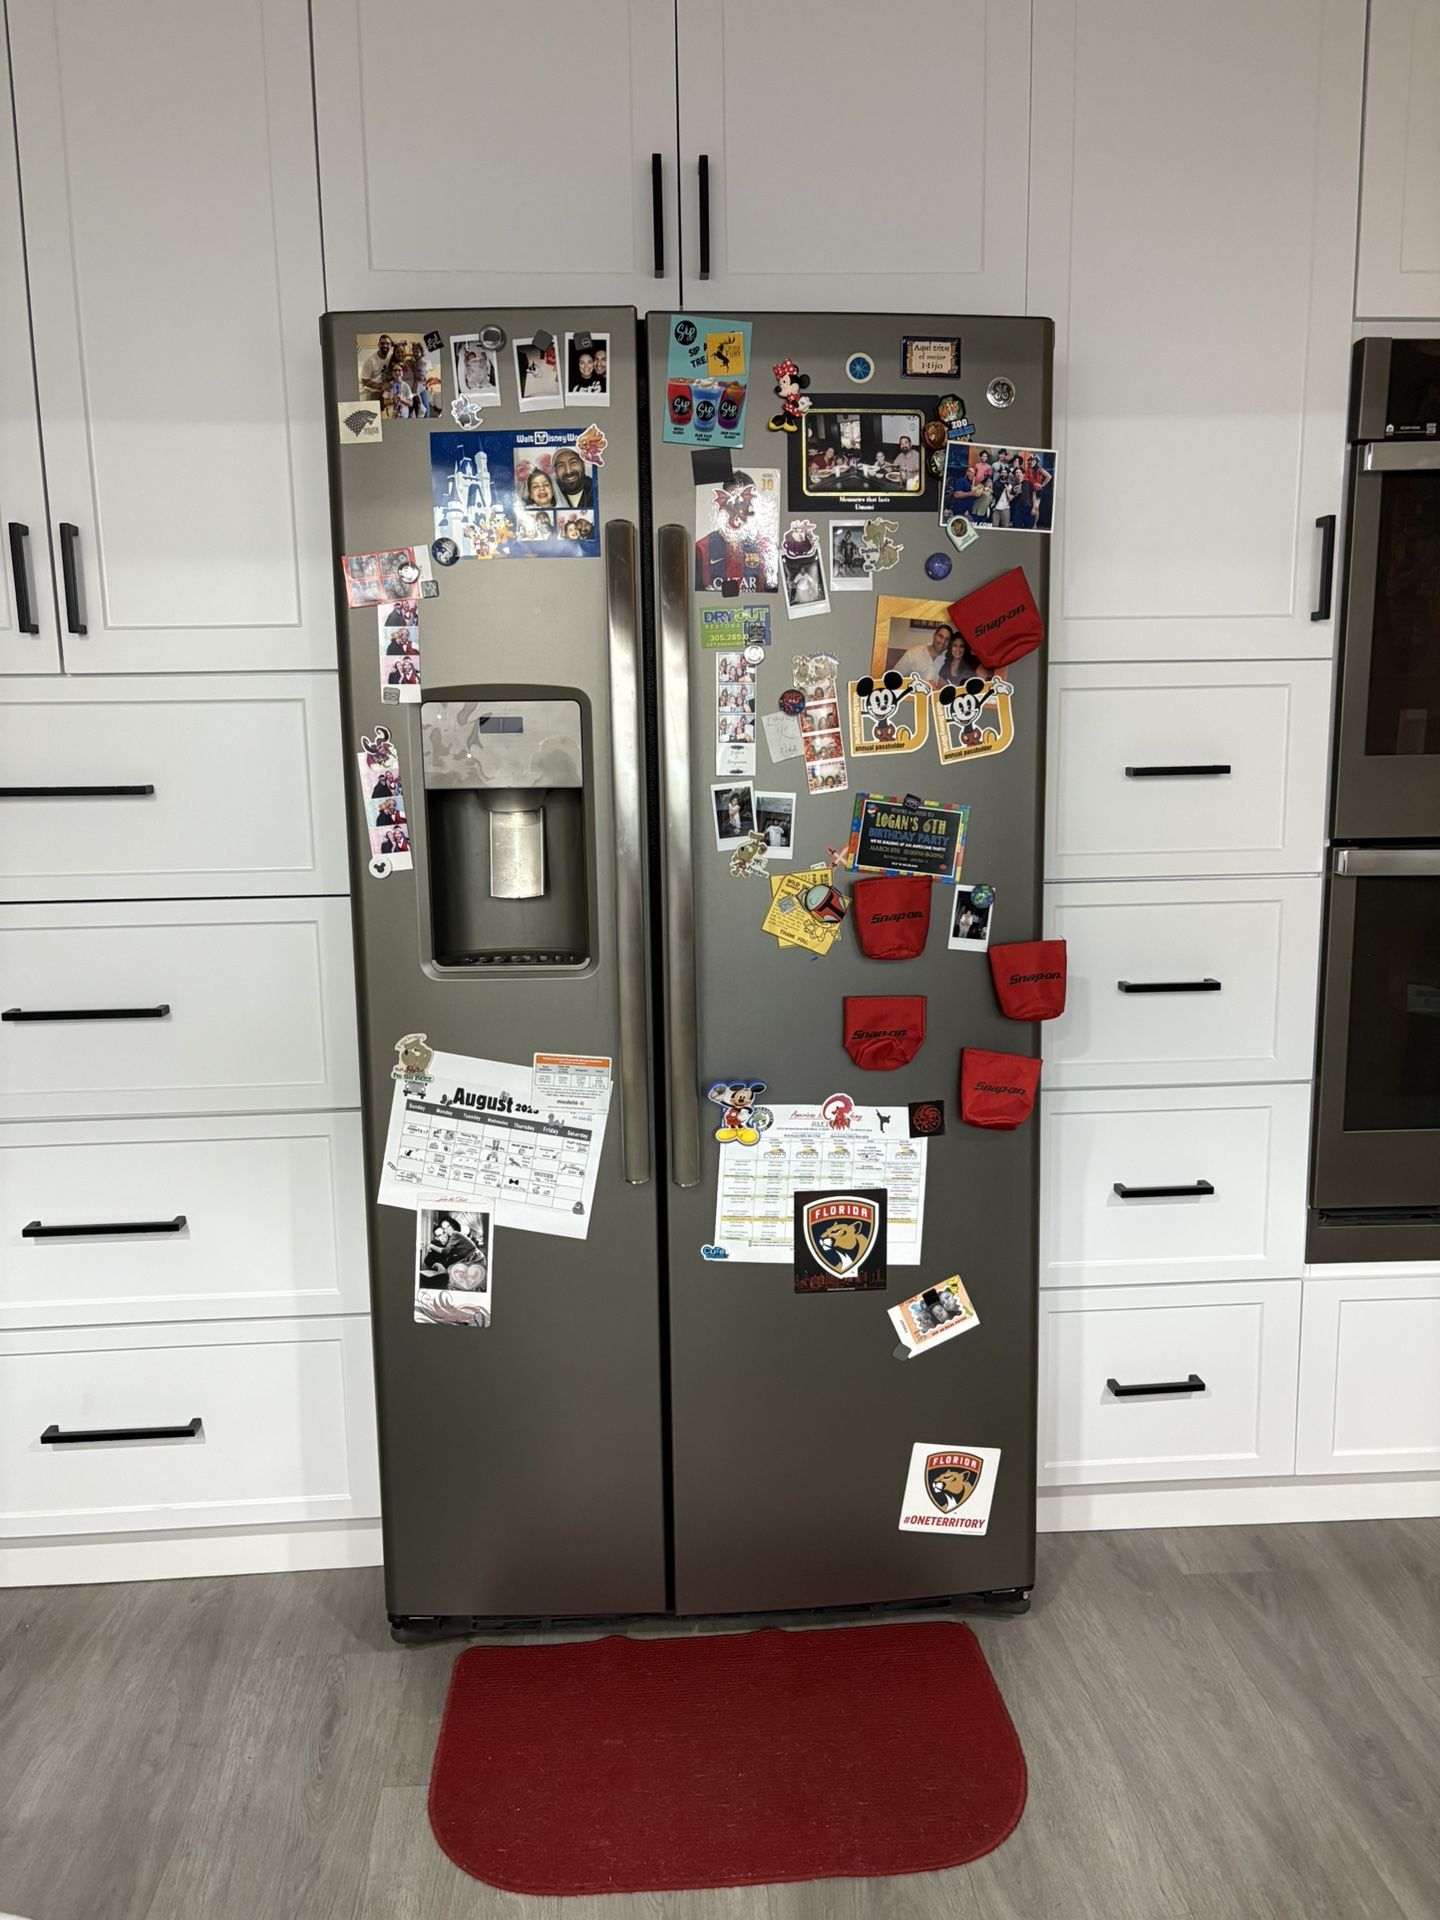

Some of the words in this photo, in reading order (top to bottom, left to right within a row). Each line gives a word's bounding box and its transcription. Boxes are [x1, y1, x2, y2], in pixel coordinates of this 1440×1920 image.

[676, 322, 696, 341] Sip
[688, 346, 700, 357] SIP
[690, 356, 708, 368] TRE
[921, 362, 943, 370] Hijo
[674, 398, 690, 412] Sip
[698, 403, 714, 417] Sip
[722, 402, 737, 416] Sip
[951, 419, 967, 429] ZOO
[516, 434, 534, 443] Walt
[534, 431, 567, 444] Disney
[762, 479, 773, 490] 10
[975, 604, 1026, 638] Snap-on
[875, 742, 905, 751] passholder
[944, 751, 963, 759] annual
[964, 745, 992, 756] passholder
[876, 812, 919, 831] LOGAN'S
[923, 819, 946, 834] 6TH
[869, 827, 916, 842] BIRTHDAY
[918, 833, 949, 846] PARTY
[870, 912, 924, 924] Snap-on
[780, 929, 796, 939] THANK
[1009, 972, 1063, 984] Snap-on
[852, 1030, 907, 1040] Snap-on
[974, 1082, 1027, 1096] Snap-on
[453, 1088, 514, 1113] August
[790, 1110, 816, 1118] American
[409, 1103, 426, 1111] Sunday
[436, 1108, 453, 1116] Monday
[463, 1113, 481, 1121] Tuesday
[488, 1118, 508, 1126] Wednesday
[514, 1122, 535, 1132] Thursday
[542, 1126, 559, 1136] Friday
[567, 1130, 589, 1139] Saturday
[815, 1205, 868, 1218] FLORIDA
[933, 1456, 977, 1468] FLORIDA
[904, 1515, 986, 1528] #ONETERRITORY
